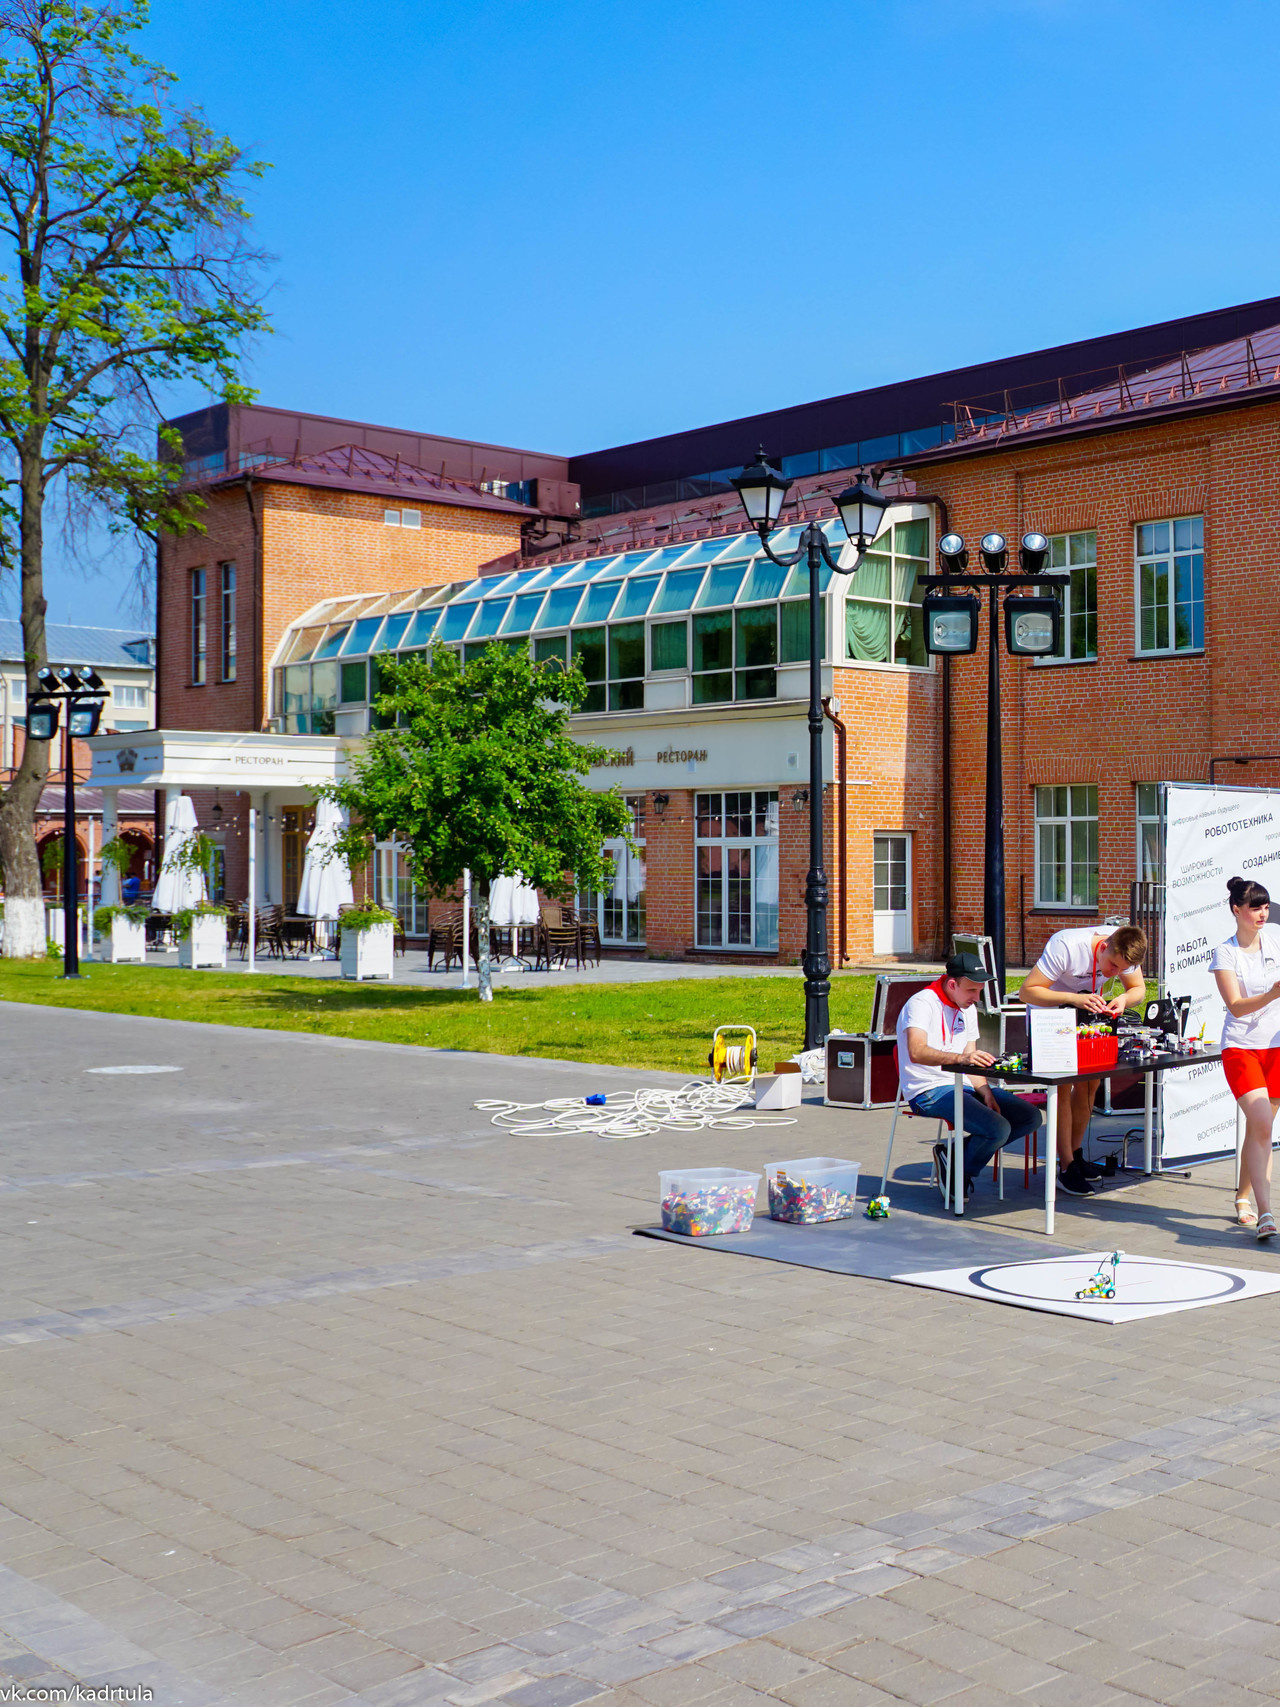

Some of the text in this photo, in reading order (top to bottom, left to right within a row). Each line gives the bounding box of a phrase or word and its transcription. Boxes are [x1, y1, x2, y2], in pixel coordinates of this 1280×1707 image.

[235, 756, 284, 766] РЕСТОРАН
[657, 749, 708, 763] РЕСТОРАН
[1204, 812, 1274, 839] РОБОТОТЕХНИКА
[1180, 857, 1214, 874] ШИРОКИЕ
[1172, 866, 1224, 889] ВОЗМОЖНОСТИ
[1173, 901, 1222, 922] программирование
[1176, 936, 1208, 956] РАБОТА
[1169, 962, 1176, 974] В
